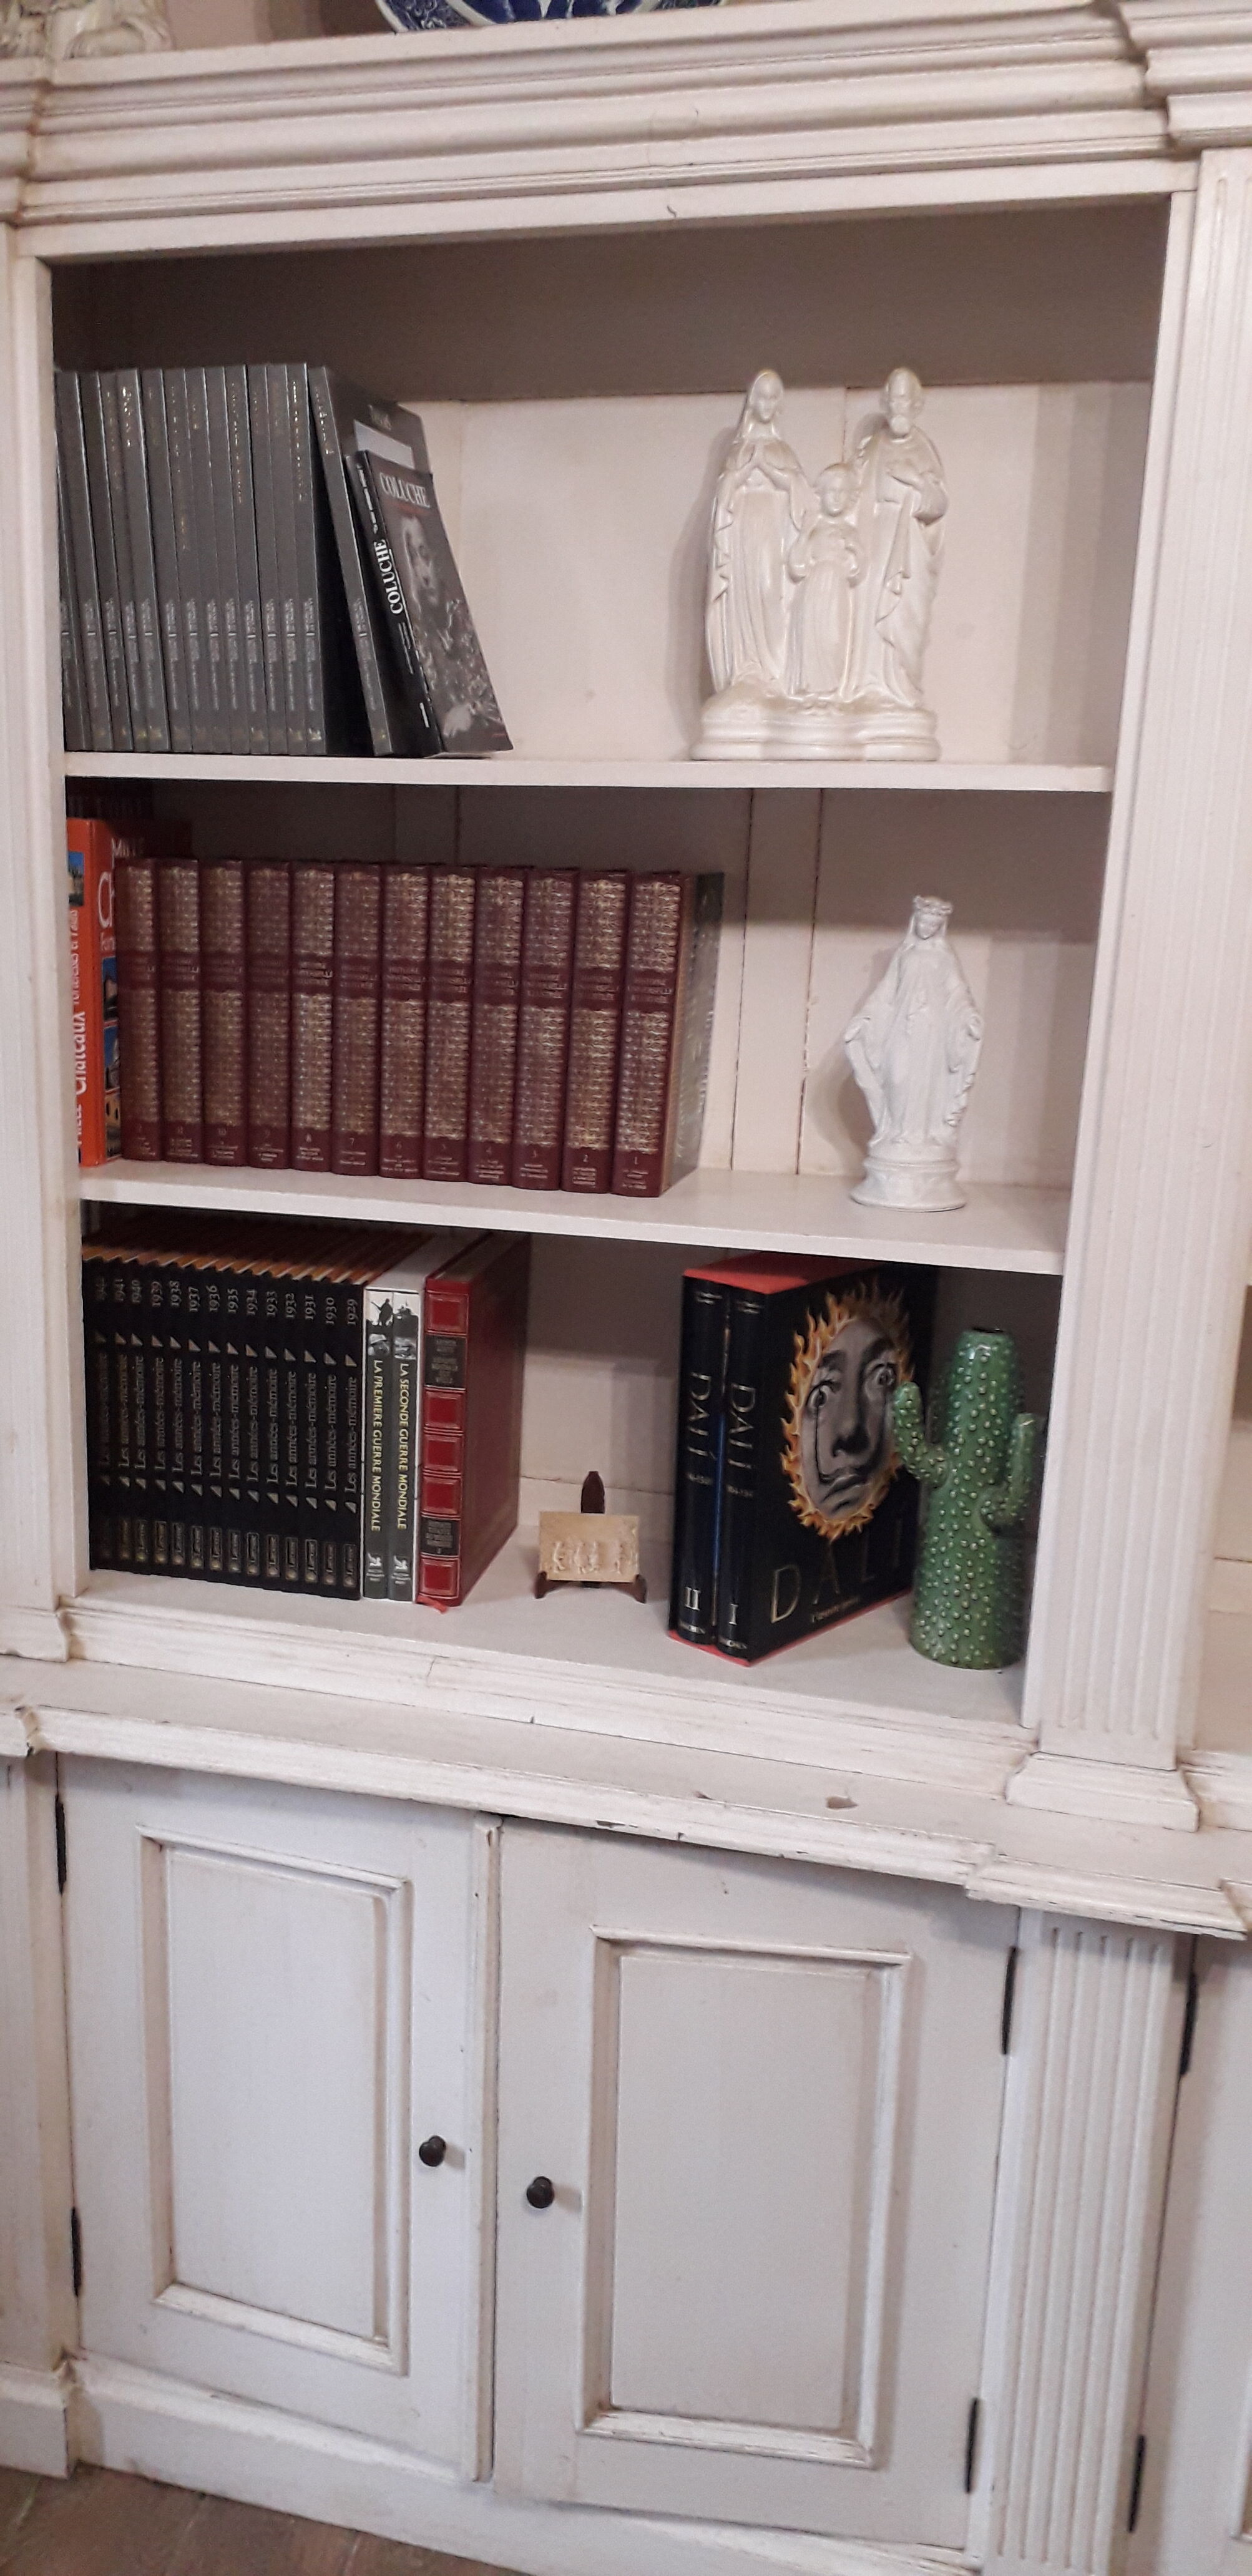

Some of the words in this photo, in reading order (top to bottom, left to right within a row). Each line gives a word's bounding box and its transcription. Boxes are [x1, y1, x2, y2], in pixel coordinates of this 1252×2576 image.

[379, 472, 431, 508] COLUCHE
[373, 537, 404, 615] COLUCHE
[583, 1154, 589, 1163] 2
[130, 1279, 143, 1304] 1940
[151, 1281, 164, 1308] 1939
[169, 1279, 182, 1308] 1938
[188, 1286, 200, 1313] 1937
[205, 1284, 219, 1313] 1936
[225, 1288, 239, 1314] 1935
[245, 1289, 258, 1316] 1934
[264, 1290, 277, 1317] 1933
[283, 1292, 296, 1319] 1932
[304, 1294, 316, 1320] 1931
[324, 1296, 336, 1326] 1930
[346, 1298, 358, 1327] 1929
[373, 1360, 383, 1373] LA
[399, 1362, 409, 1377] LA
[372, 1375, 383, 1427] PREMIERE
[399, 1378, 409, 1427] SECONDE
[134, 1450, 146, 1470] Les
[153, 1450, 165, 1470] Les
[372, 1429, 383, 1473] GUERRE
[398, 1428, 409, 1471] GUERRE
[172, 1453, 184, 1473] Les
[190, 1455, 203, 1476] Les
[210, 1456, 222, 1478] Les
[228, 1458, 240, 1480] Les
[247, 1461, 259, 1482] Les
[266, 1463, 279, 1483] Les
[285, 1466, 298, 1486] Les
[305, 1468, 318, 1488] Les
[324, 1470, 337, 1491] Les
[344, 1472, 358, 1493] Les
[371, 1475, 382, 1531] MONDIALE
[396, 1473, 408, 1530] MONDIALE
[683, 1586, 701, 1612] II
[728, 1603, 740, 1626] I
